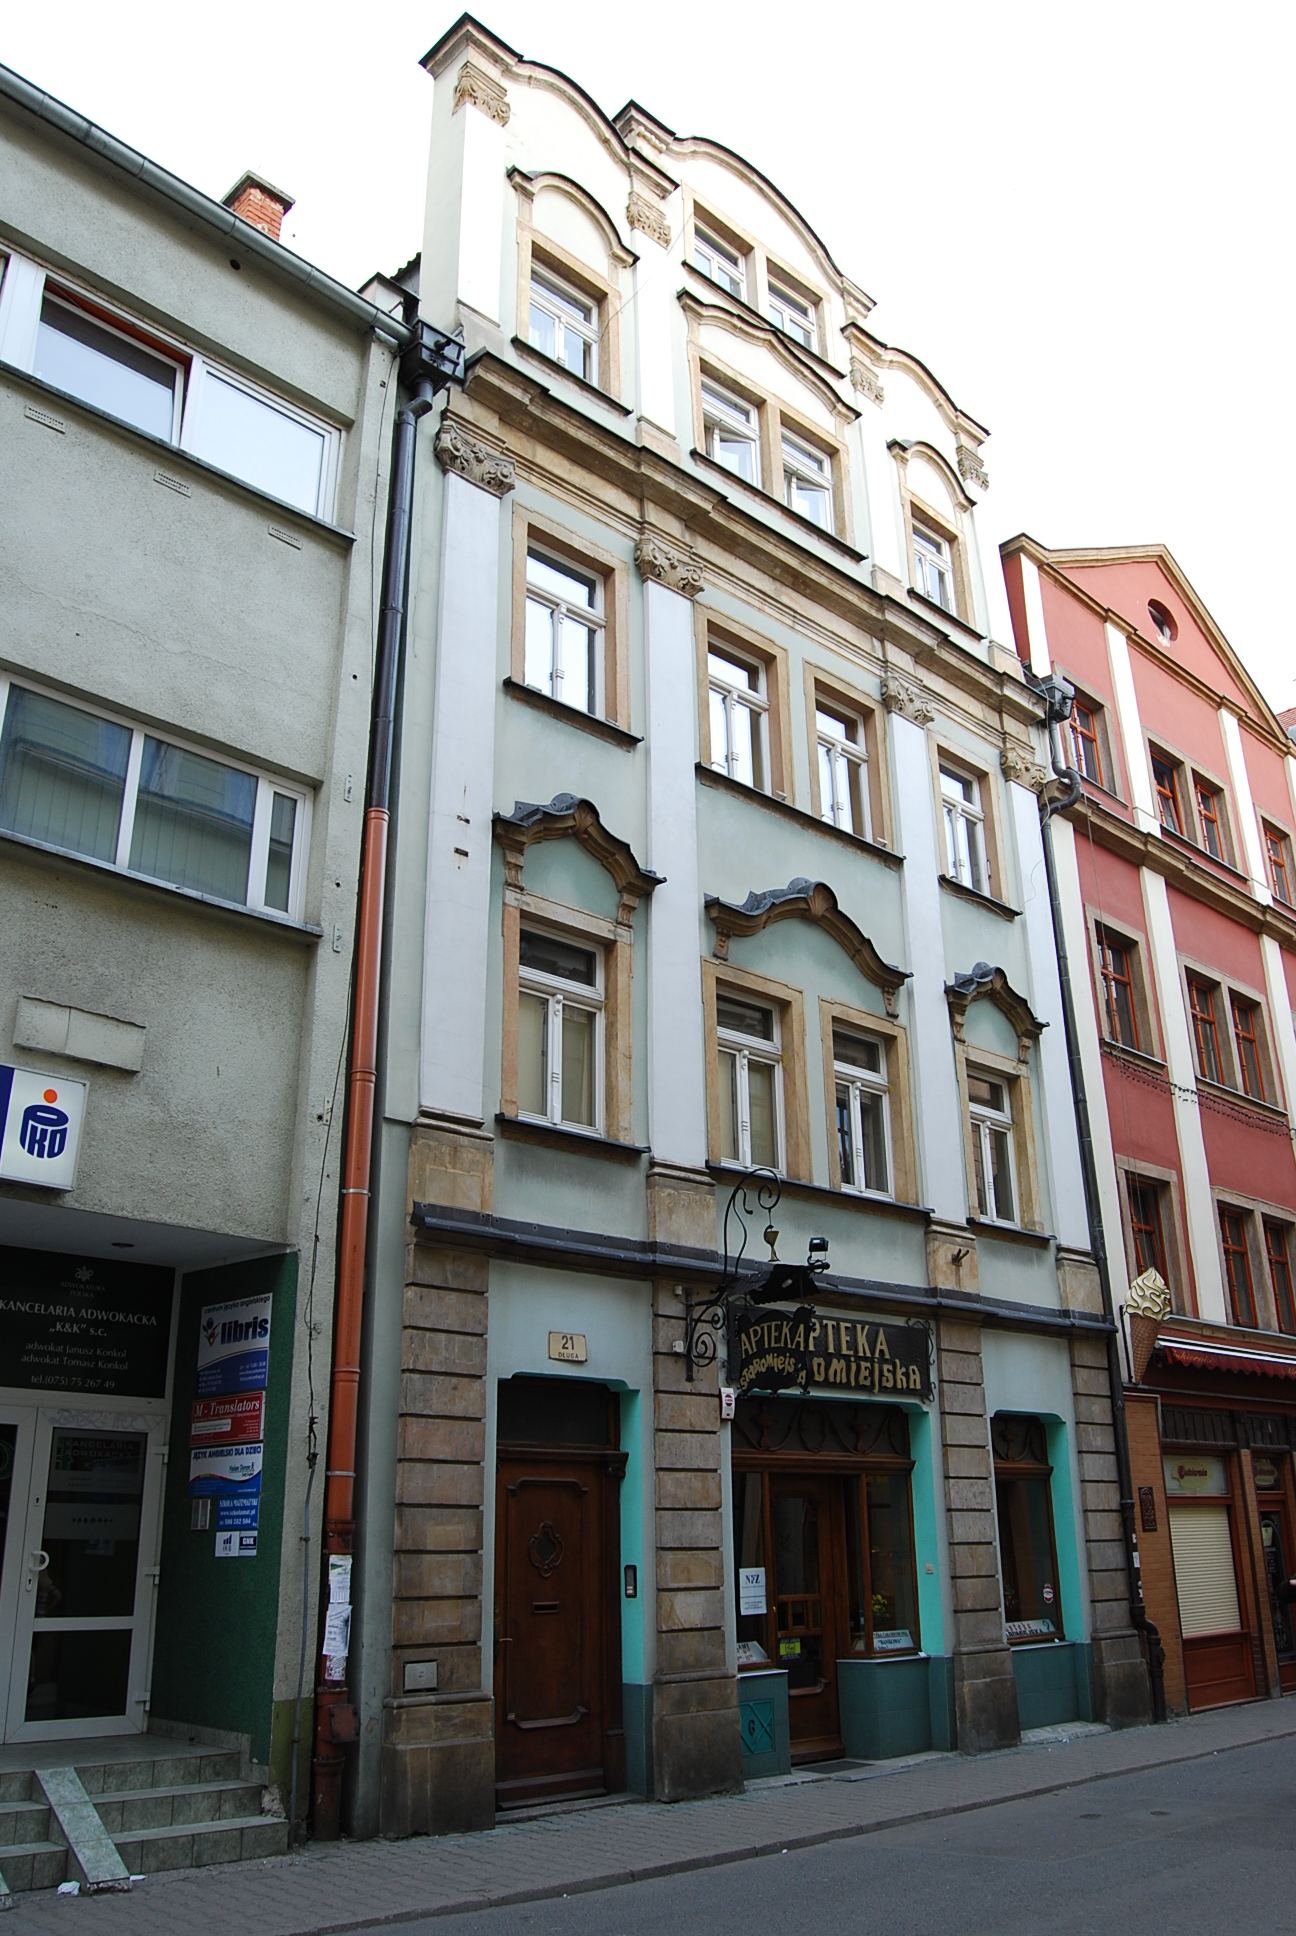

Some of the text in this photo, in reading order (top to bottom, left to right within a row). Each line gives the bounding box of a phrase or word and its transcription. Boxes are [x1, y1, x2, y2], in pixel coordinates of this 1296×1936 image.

[0, 1300, 157, 1326] KANCELARIA ADWOKACKA
[89, 1327, 107, 1336] s.c.
[221, 1316, 269, 1345] libris
[808, 1318, 891, 1359] PTEKA
[561, 1335, 574, 1350] 21
[740, 1321, 805, 1359] APTEKA
[25, 1341, 127, 1358] adwokat Janusz Konkol
[21, 1354, 129, 1370] adwokat Tomasz Konkol
[71, 1377, 82, 1386] 75
[85, 1378, 101, 1388] 267
[104, 1379, 115, 1389] 49
[210, 1399, 260, 1416] Translators
[234, 1447, 244, 1456] DLA
